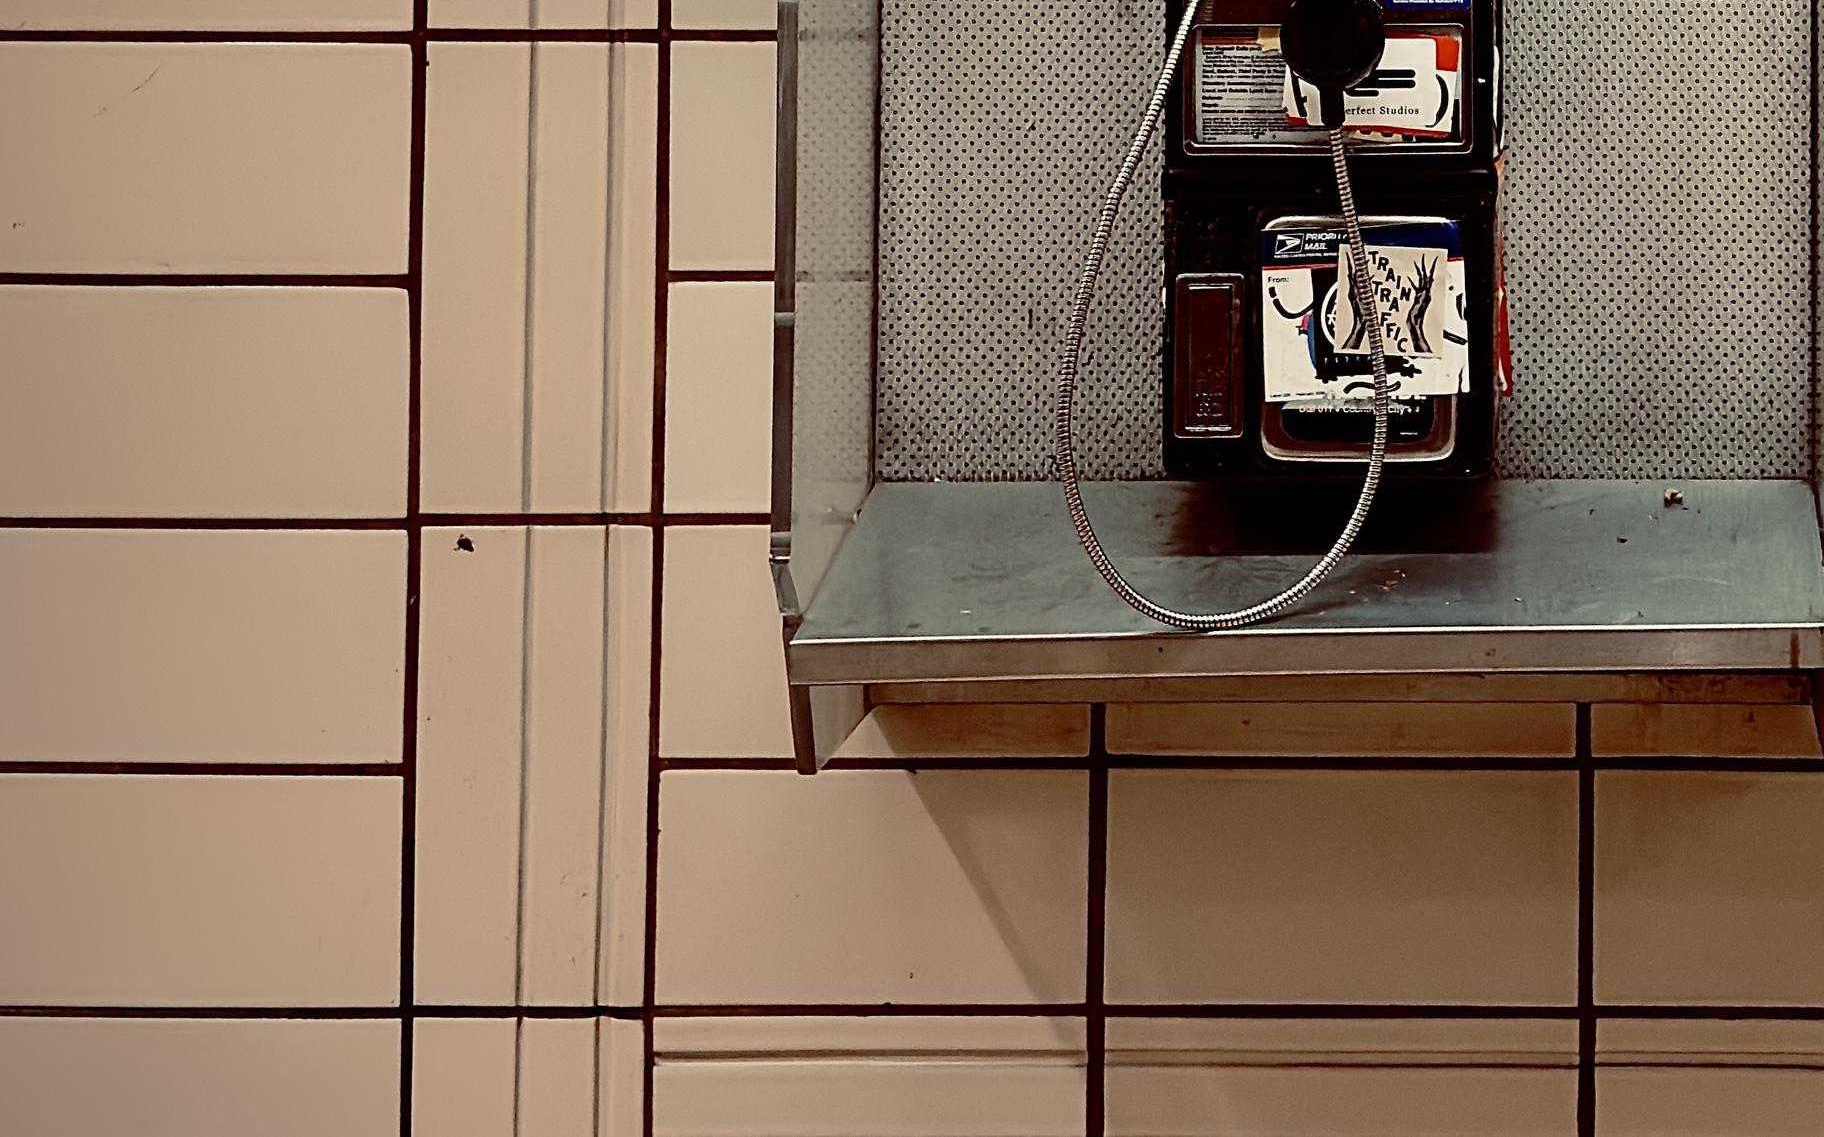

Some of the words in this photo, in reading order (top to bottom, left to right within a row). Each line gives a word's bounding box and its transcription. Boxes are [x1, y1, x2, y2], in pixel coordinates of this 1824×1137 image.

[1344, 106, 1376, 115] erfect
[1379, 106, 1420, 115] Studios
[1304, 242, 1328, 250] MAIL
[1368, 251, 1412, 302] TRAIN
